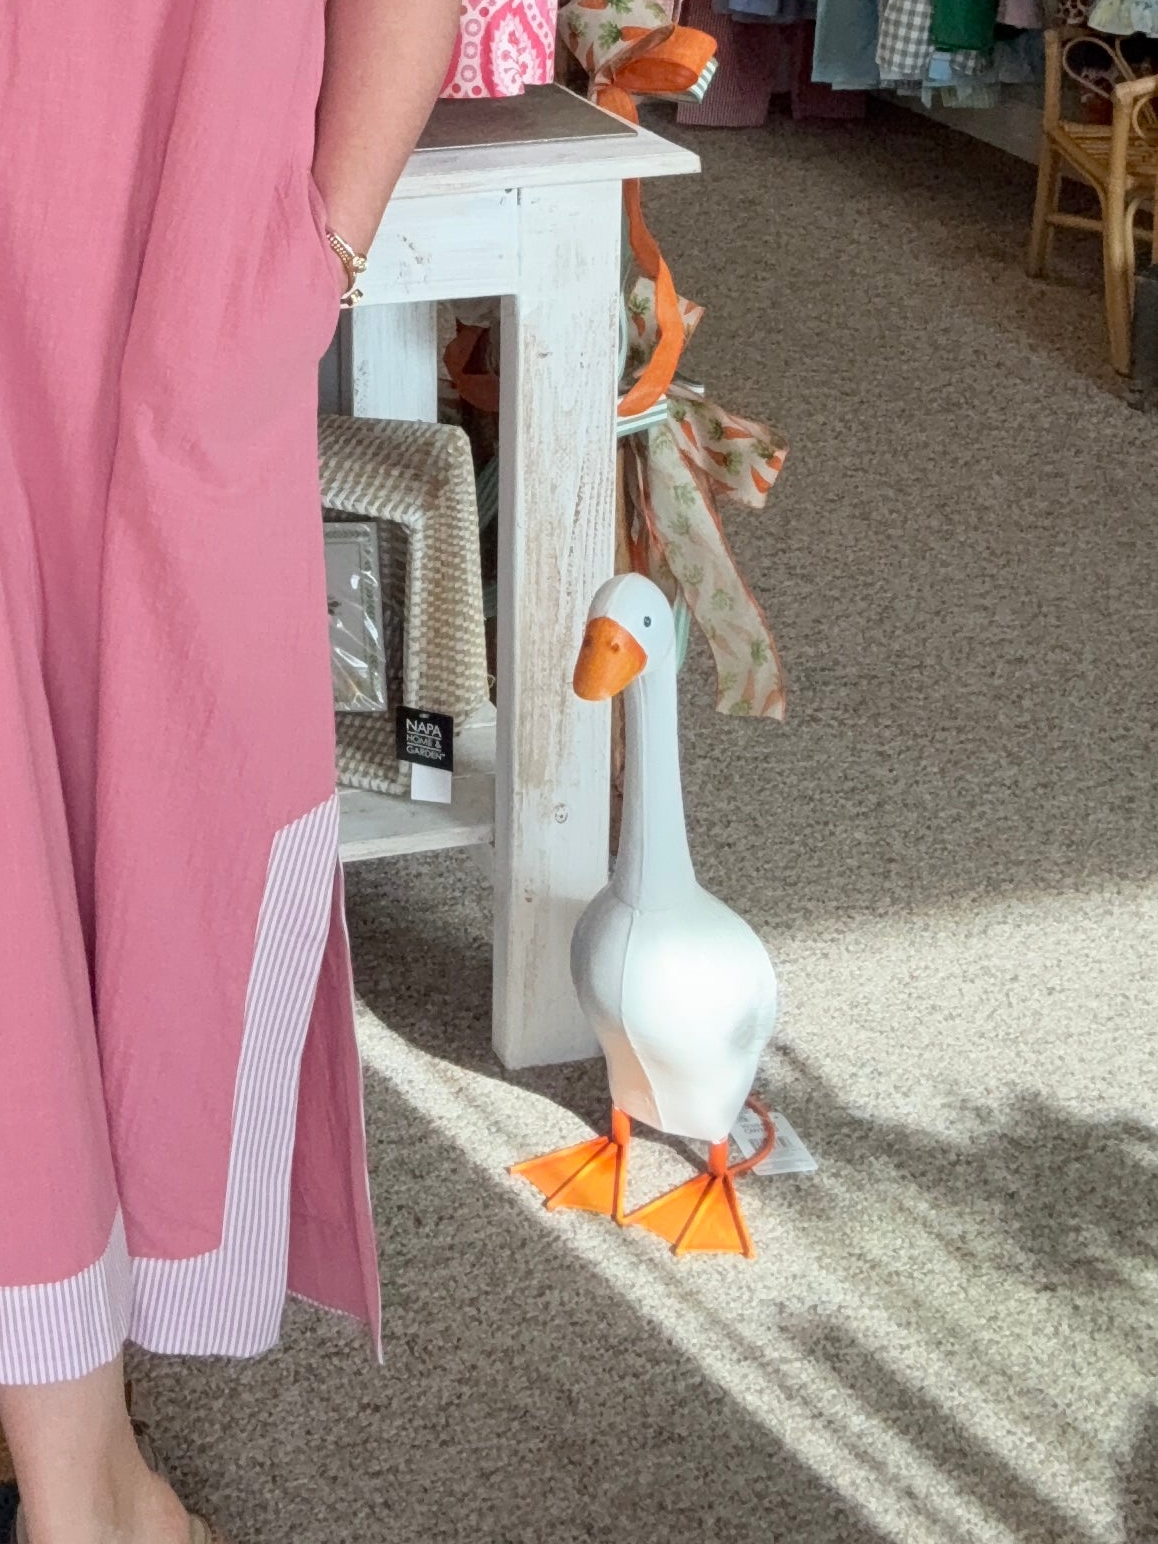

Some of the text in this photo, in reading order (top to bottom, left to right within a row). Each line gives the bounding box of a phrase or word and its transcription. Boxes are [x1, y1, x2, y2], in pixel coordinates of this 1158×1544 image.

[406, 718, 442, 738] NAPA
[406, 734, 442, 749] HOME &
